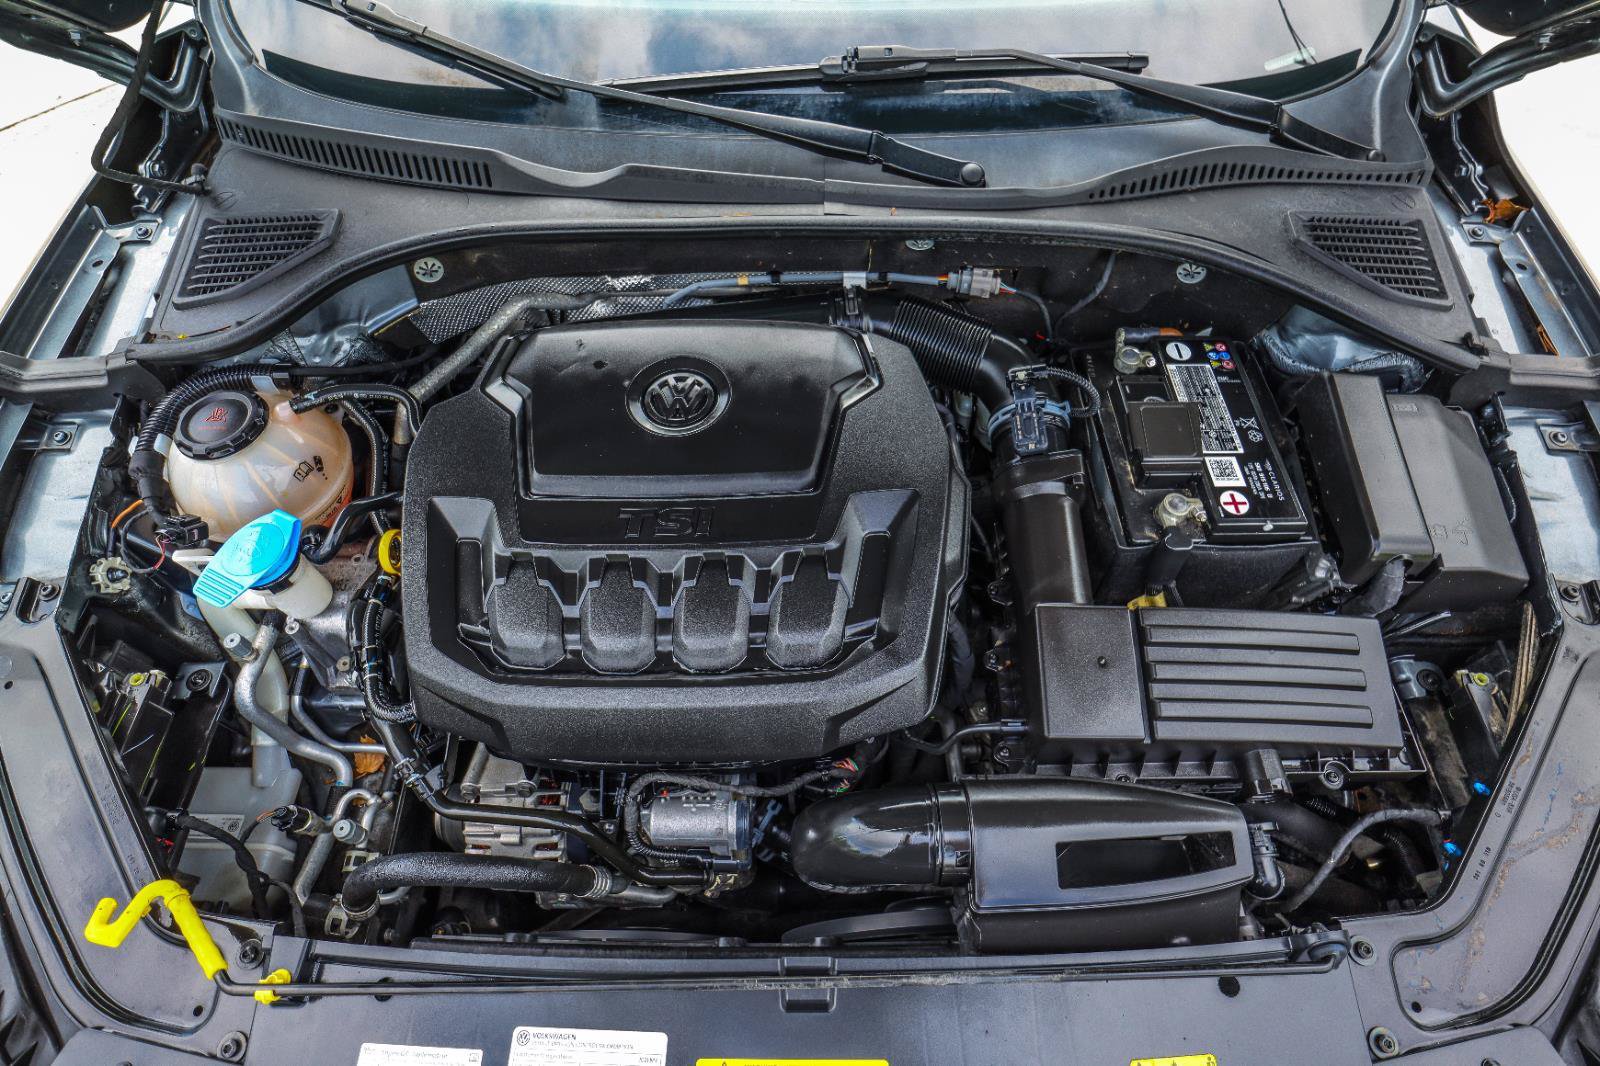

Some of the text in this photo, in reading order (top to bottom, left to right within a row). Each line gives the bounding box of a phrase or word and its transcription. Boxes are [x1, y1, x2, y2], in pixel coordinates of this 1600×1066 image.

[1269, 471, 1285, 501] CLARIOS
[619, 506, 716, 538] TSI
[532, 1032, 577, 1040] VOLKSWAGEN
